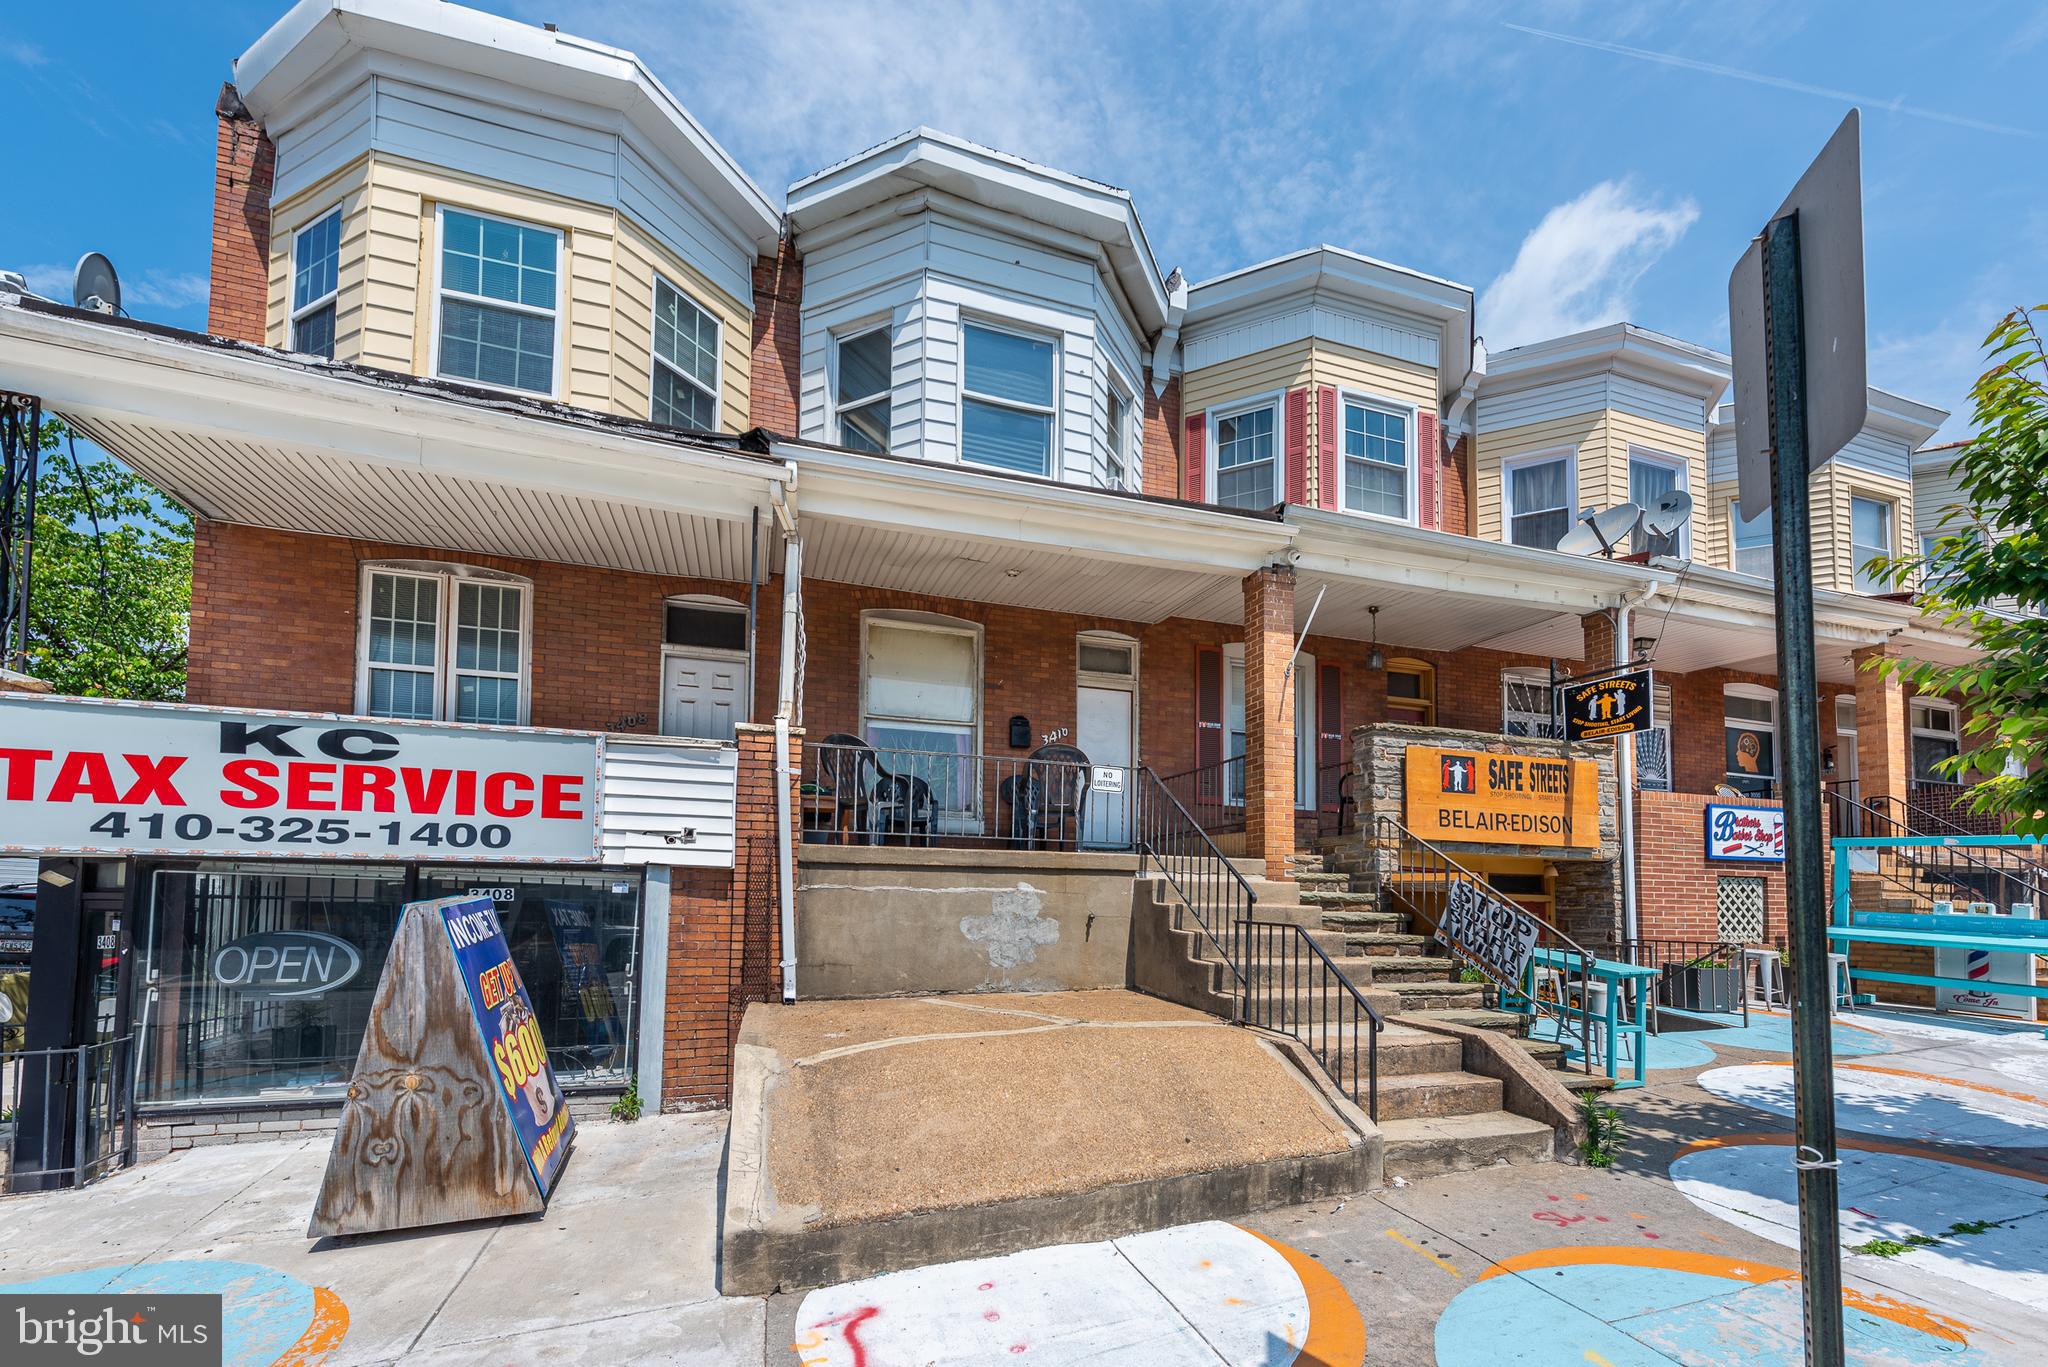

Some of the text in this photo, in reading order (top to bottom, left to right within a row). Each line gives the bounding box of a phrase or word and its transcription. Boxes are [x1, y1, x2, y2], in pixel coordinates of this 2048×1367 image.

[1576, 680, 1637, 702] SAFE STREETS
[220, 721, 400, 761] KC
[1041, 727, 1068, 746] 3410
[0, 748, 583, 820] TAX SERVICE
[1094, 779, 1121, 789] LOITERING
[1102, 771, 1113, 779] NO
[1488, 758, 1569, 794] SAFE STREETS
[90, 812, 511, 848] 410-325-1400
[1439, 808, 1573, 834] BELAIR-EDISON
[1754, 828, 1774, 846] Shop
[1457, 883, 1532, 937] STOP
[98, 936, 115, 949] 3408
[215, 946, 336, 984] OPEN
[480, 966, 504, 1010] GET
[1953, 994, 2000, 1008] Come In
